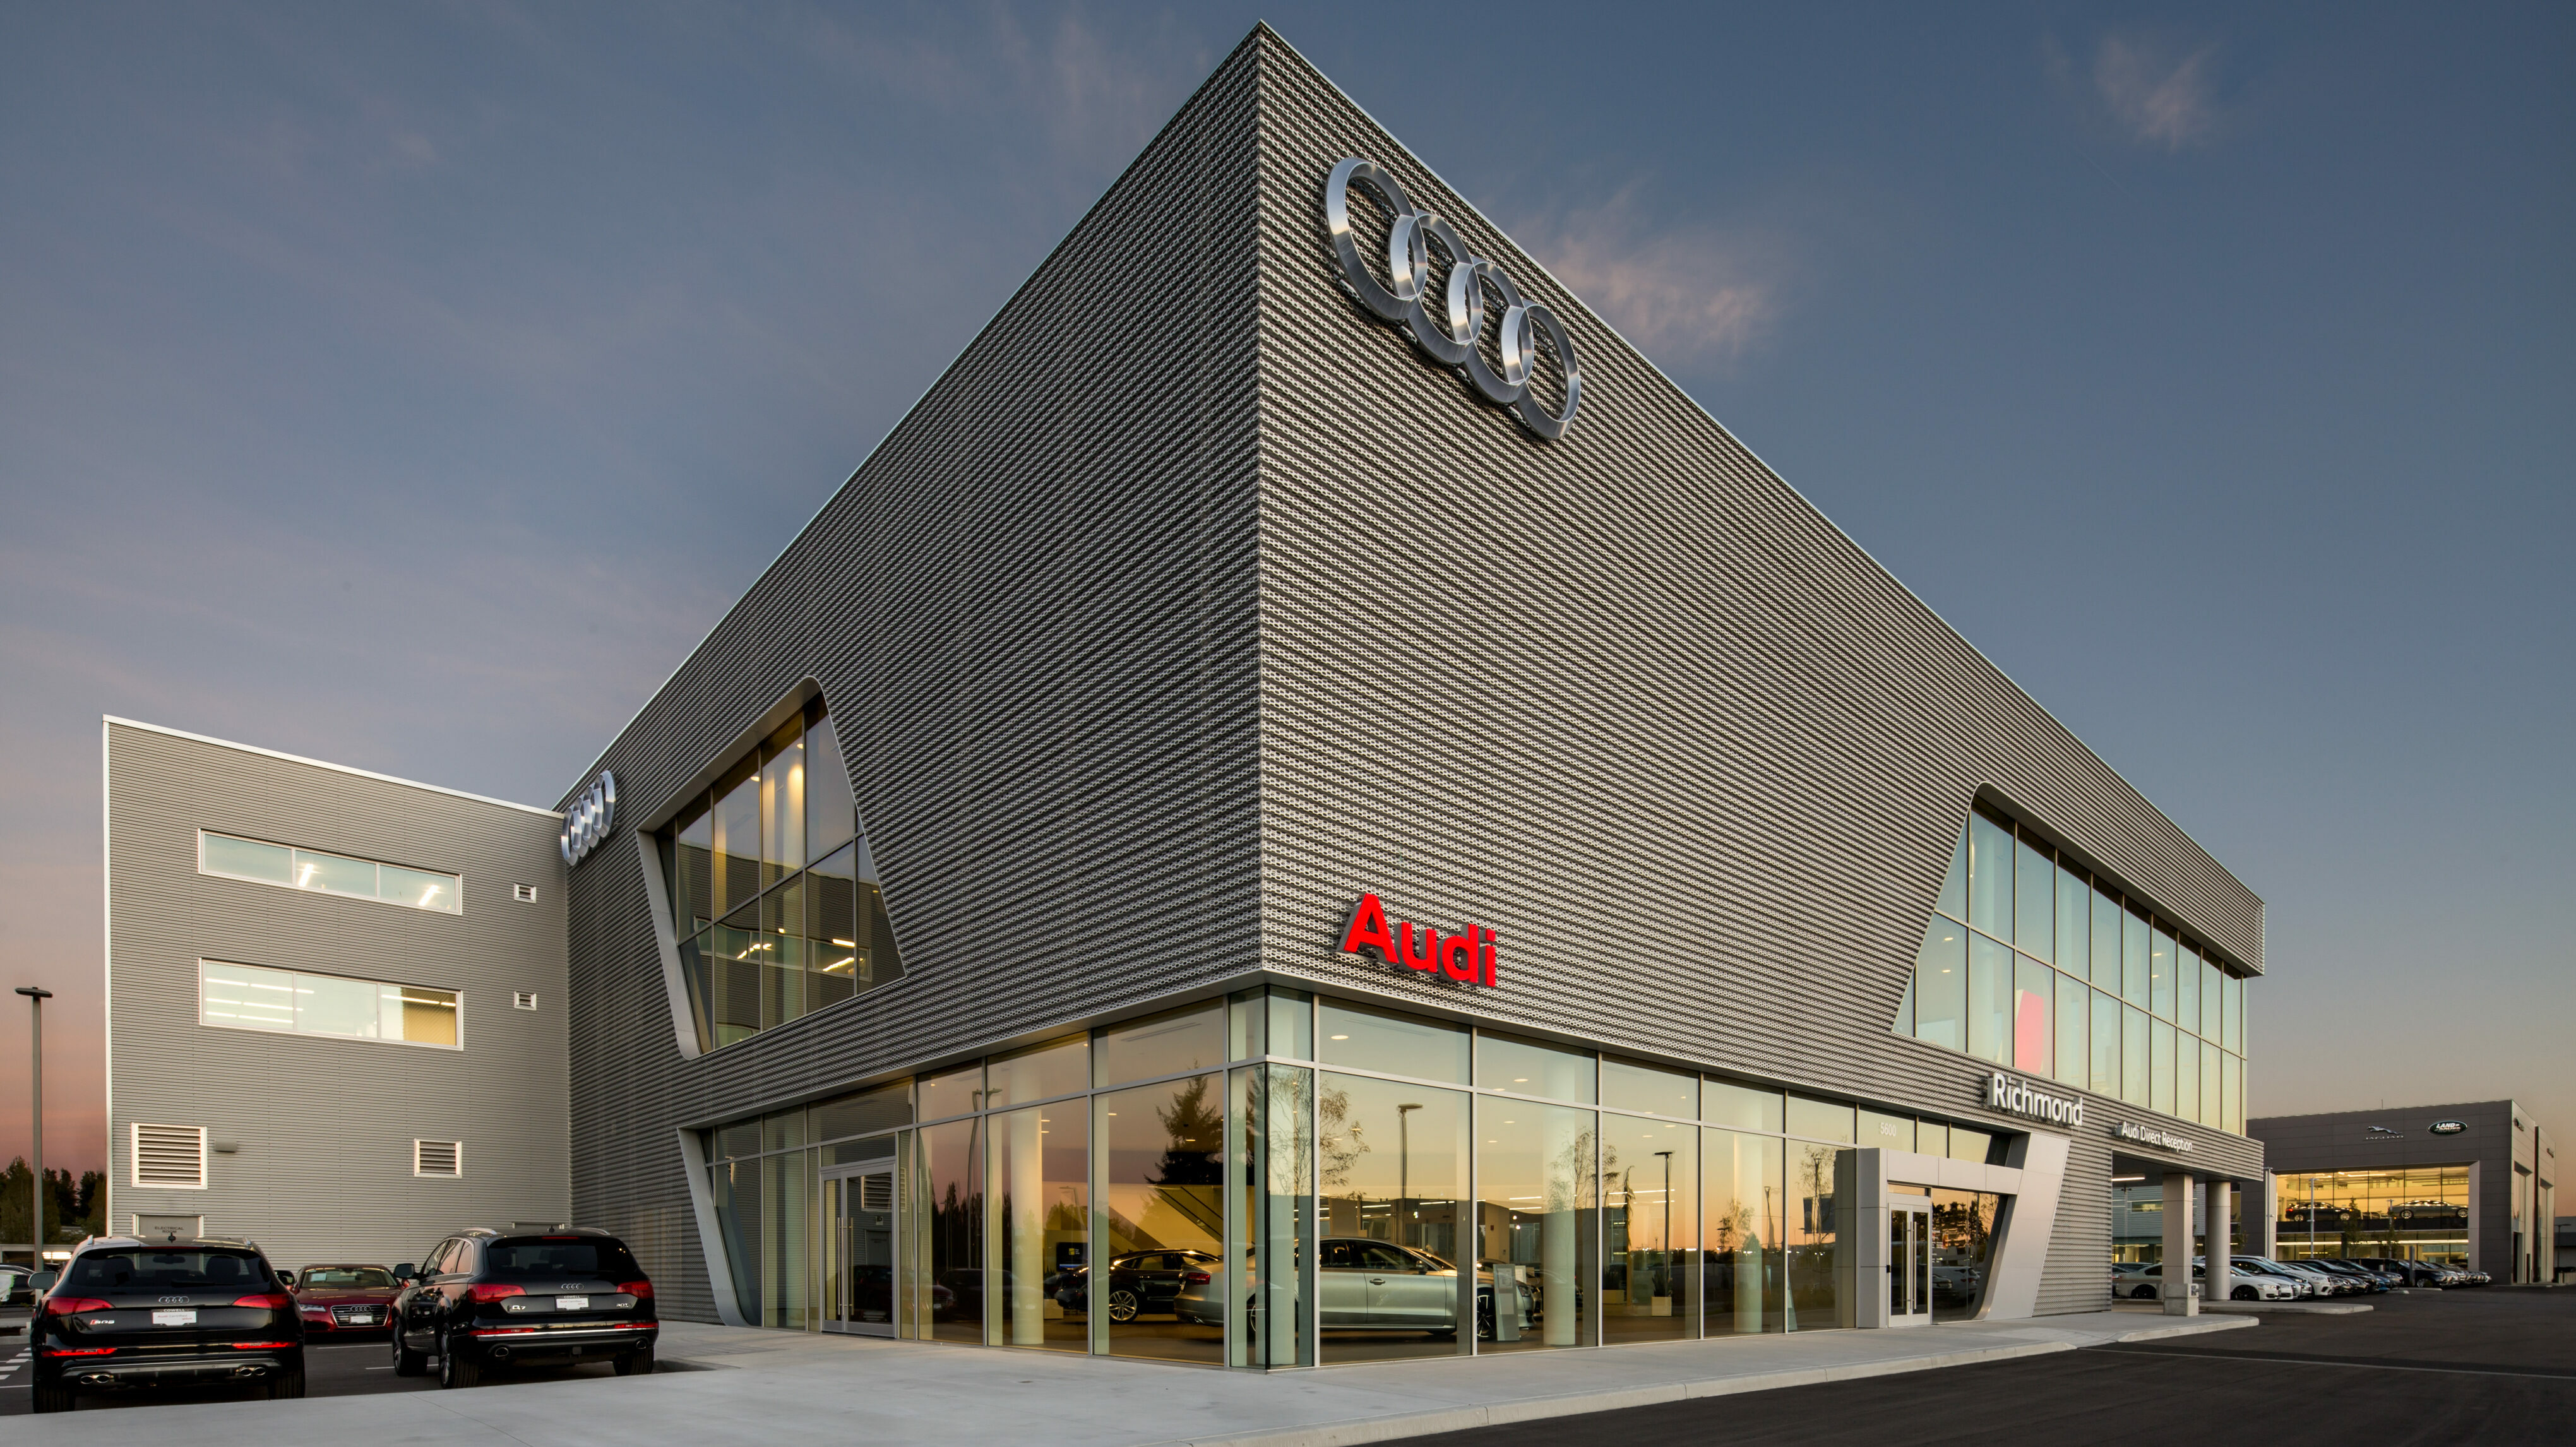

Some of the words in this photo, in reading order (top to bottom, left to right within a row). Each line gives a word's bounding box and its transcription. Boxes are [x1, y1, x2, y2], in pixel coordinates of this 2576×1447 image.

[1344, 893, 1496, 987] Audi
[1993, 1072, 2083, 1126] Richmond
[1880, 1122, 1897, 1137] 5600
[2121, 1121, 2140, 1140] Audi
[2140, 1126, 2161, 1145] Direct
[2161, 1131, 2193, 1153] Reception
